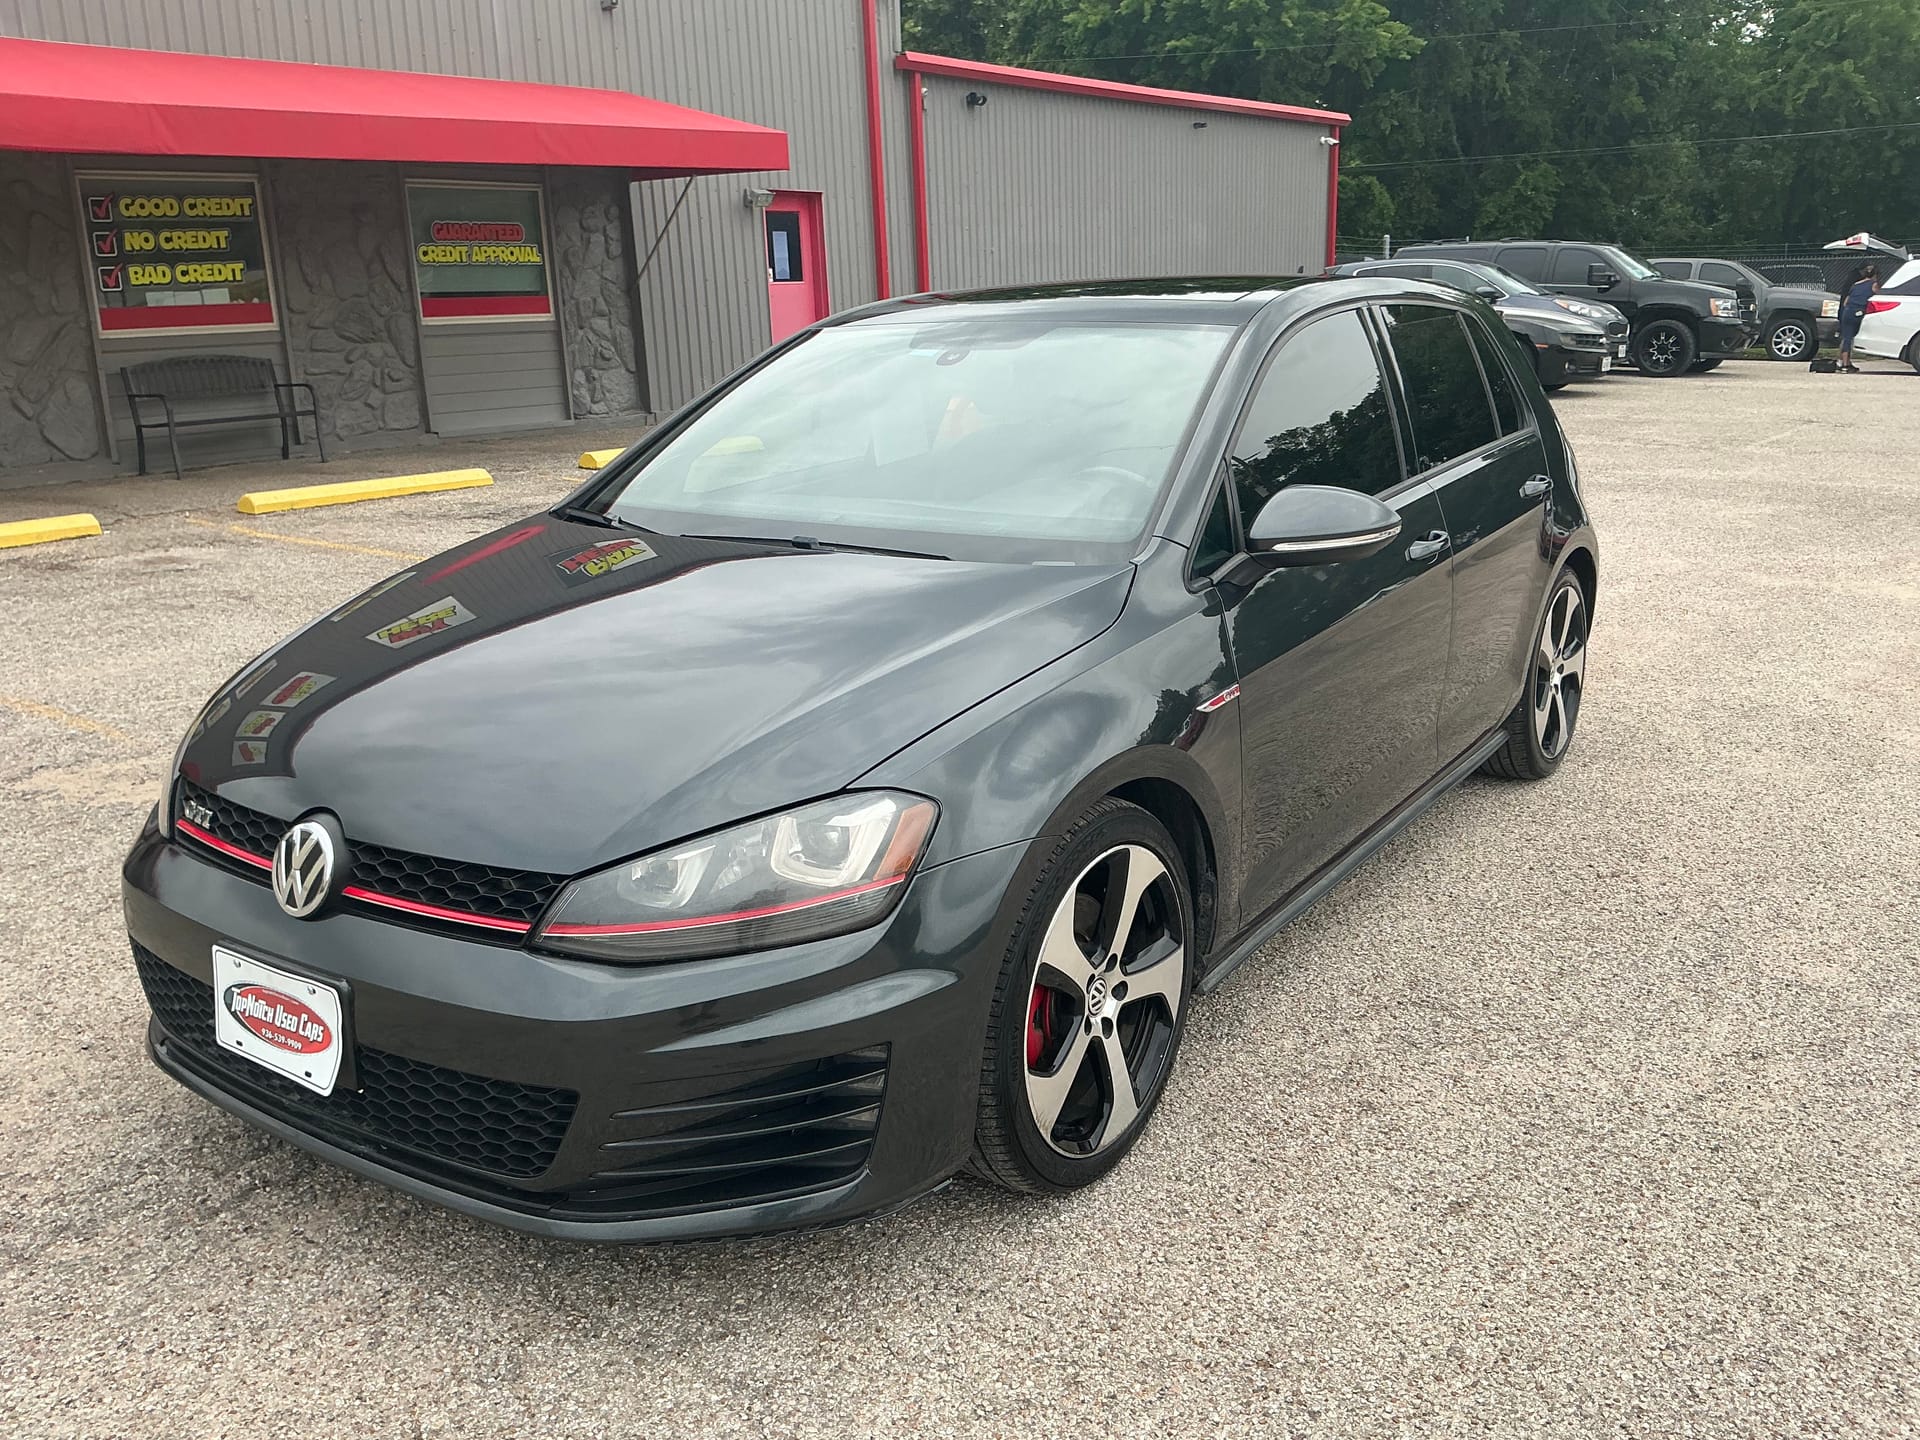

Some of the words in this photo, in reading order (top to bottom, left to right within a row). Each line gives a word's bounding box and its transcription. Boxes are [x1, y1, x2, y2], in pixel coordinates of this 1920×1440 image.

[119, 198, 180, 217] GOOD
[183, 198, 253, 217] CREDIT
[123, 231, 156, 251] NO
[158, 230, 229, 250] CREDIT
[433, 222, 522, 241] GUARANTEED
[419, 245, 469, 263] CREDIT
[471, 246, 541, 263] APPROVAL
[127, 264, 172, 286] BAD
[175, 262, 244, 284] CREDIT
[274, 1003, 299, 1033] USED
[298, 1012, 325, 1043] CARS
